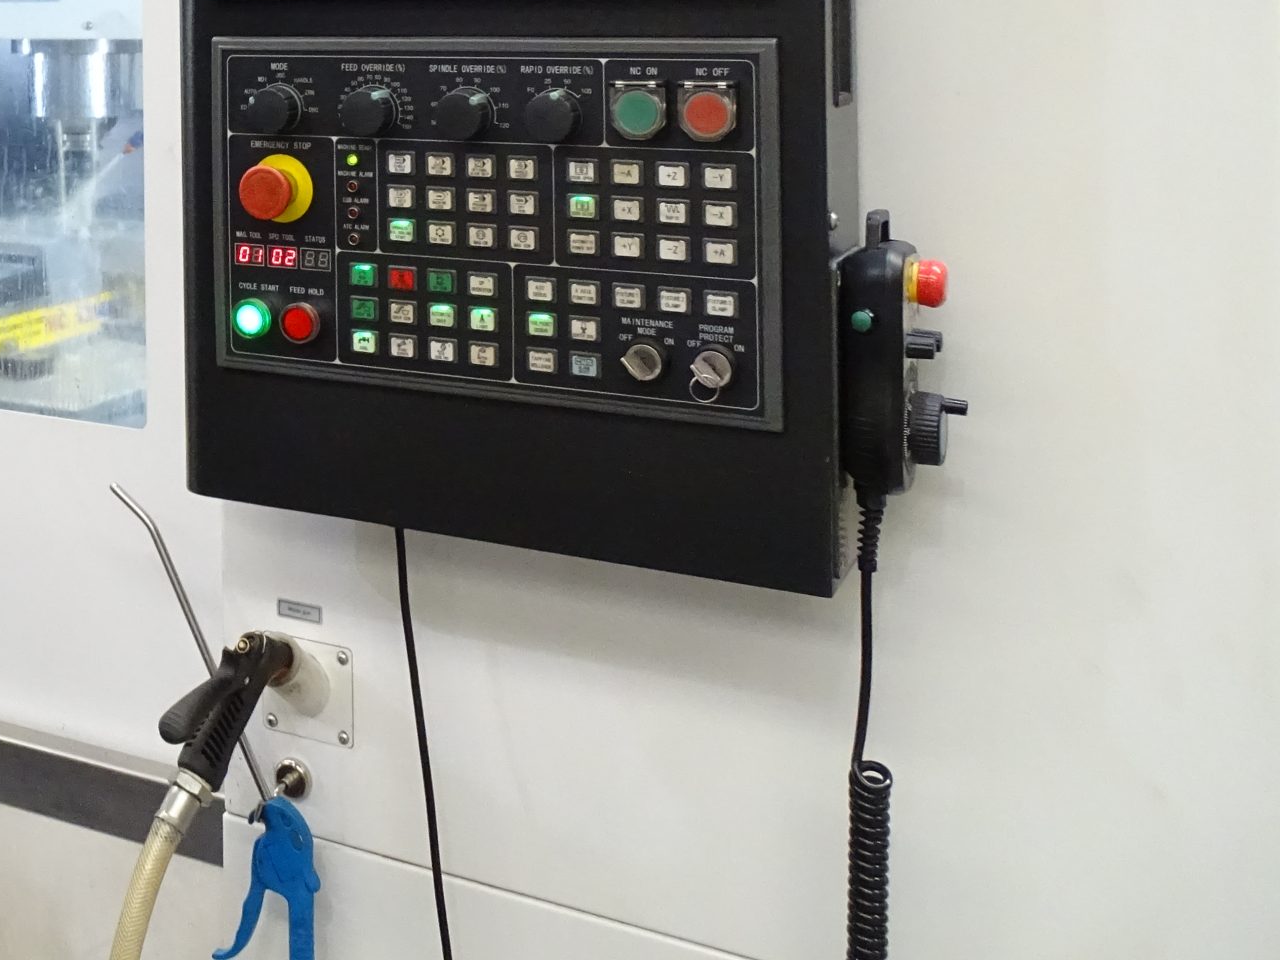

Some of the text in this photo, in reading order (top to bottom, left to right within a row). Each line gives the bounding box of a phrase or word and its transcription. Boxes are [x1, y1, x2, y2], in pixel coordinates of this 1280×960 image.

[270, 63, 288, 71] MODE
[361, 64, 406, 72] OVERRIDE(%)
[429, 64, 506, 74] SPINDLE OVERRIDE(%)
[546, 66, 593, 75] OVERRIDE(%)
[630, 67, 658, 75] NC ON
[696, 68, 730, 76] NC OFF
[250, 140, 312, 150] EMERGENCY STOP
[304, 236, 326, 244] STATUS
[238, 246, 262, 263] 01
[272, 248, 296, 265] 02
[238, 282, 279, 292] CYCLE START
[290, 286, 324, 296] FEED HOLD
[622, 317, 674, 328] MAINTENANCE
[638, 328, 656, 336] MODE
[698, 324, 734, 334] PROGRAM
[699, 333, 734, 342] PROTECT
[734, 344, 744, 352] ON
